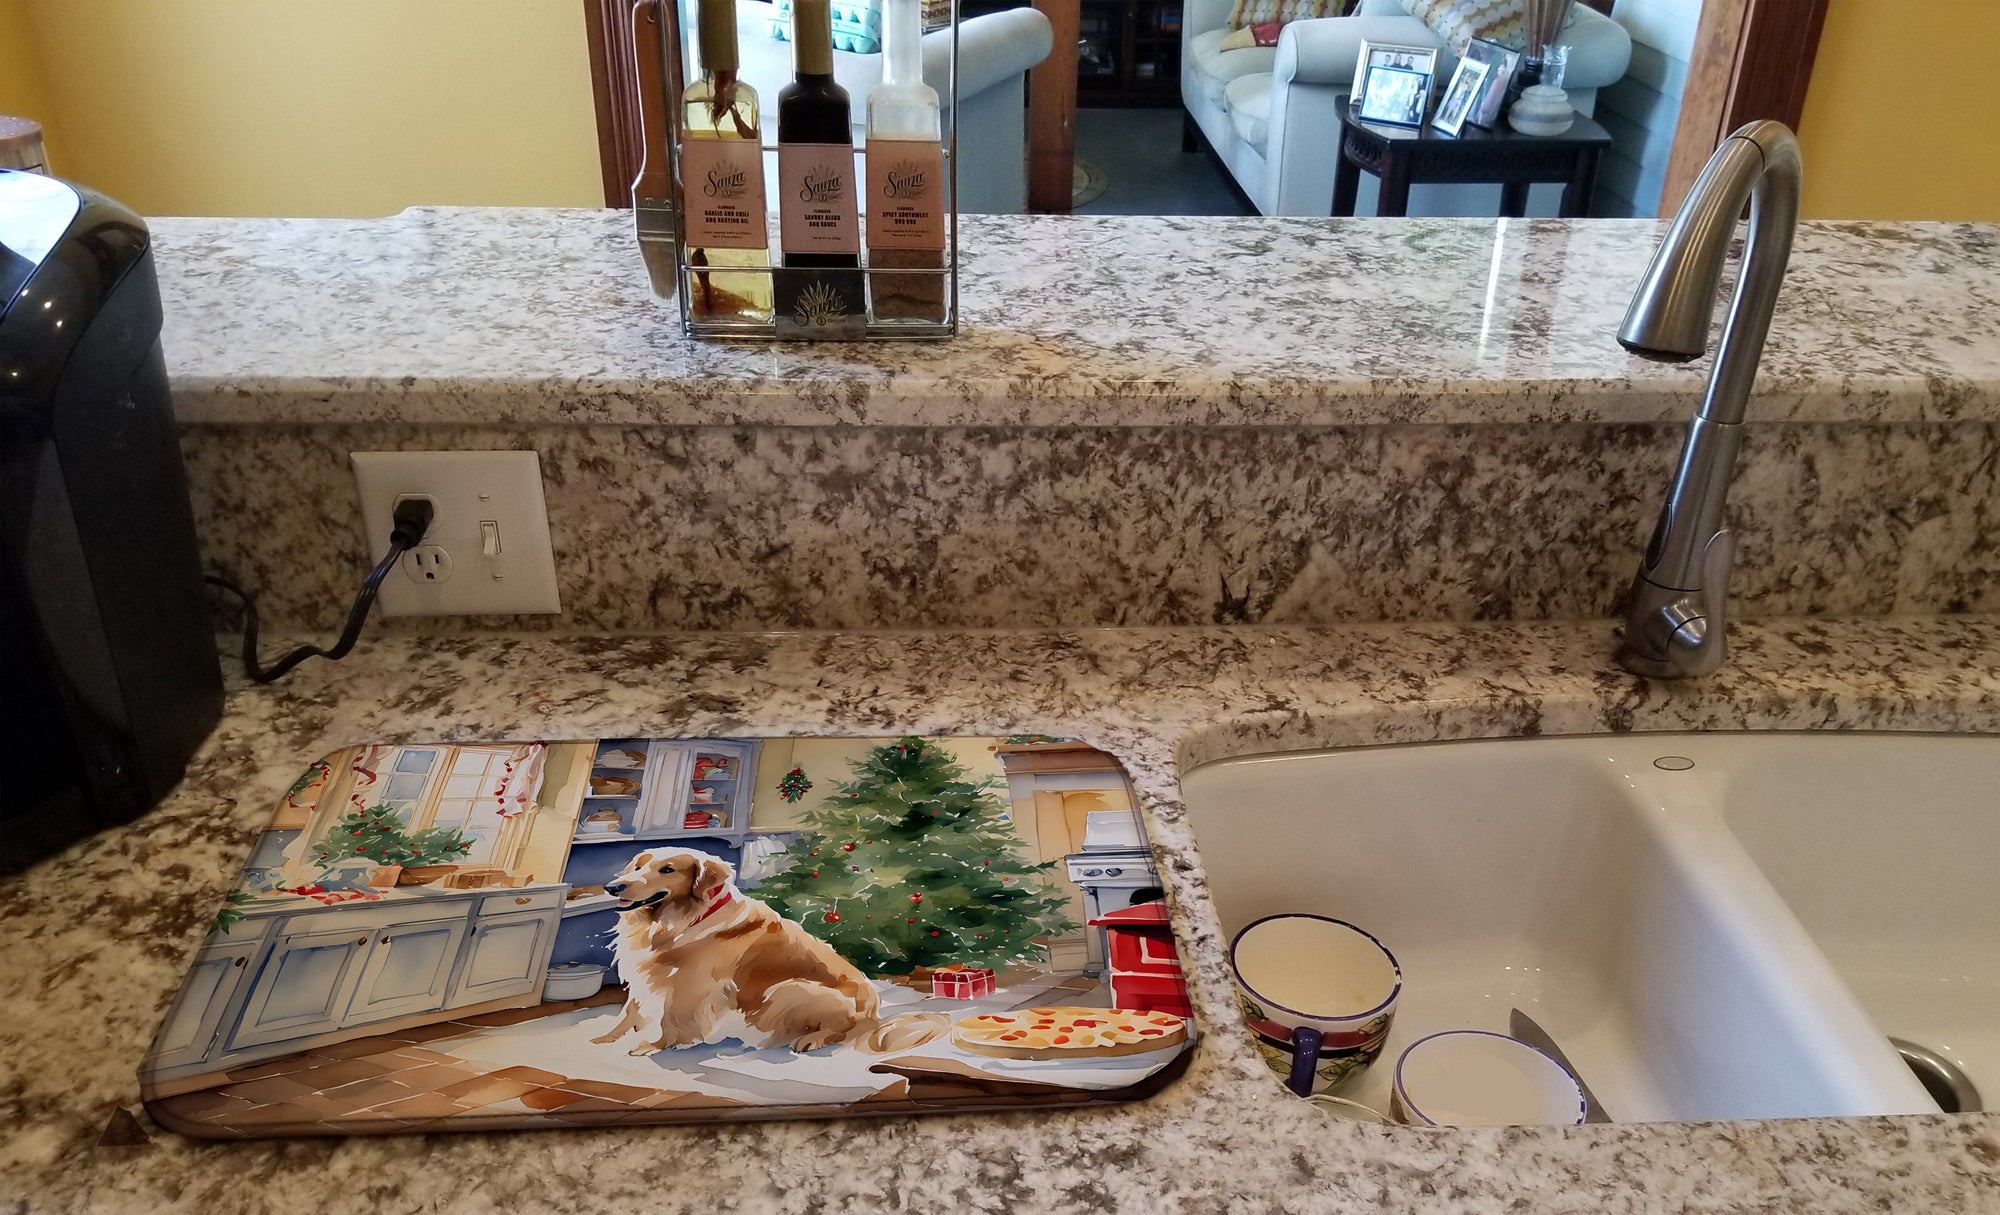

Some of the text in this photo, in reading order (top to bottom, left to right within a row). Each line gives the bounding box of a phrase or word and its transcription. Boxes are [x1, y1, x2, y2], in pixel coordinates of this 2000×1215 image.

[704, 170, 744, 197] Sauza
[800, 176, 841, 202] Sauza
[884, 172, 924, 198] Sauza
